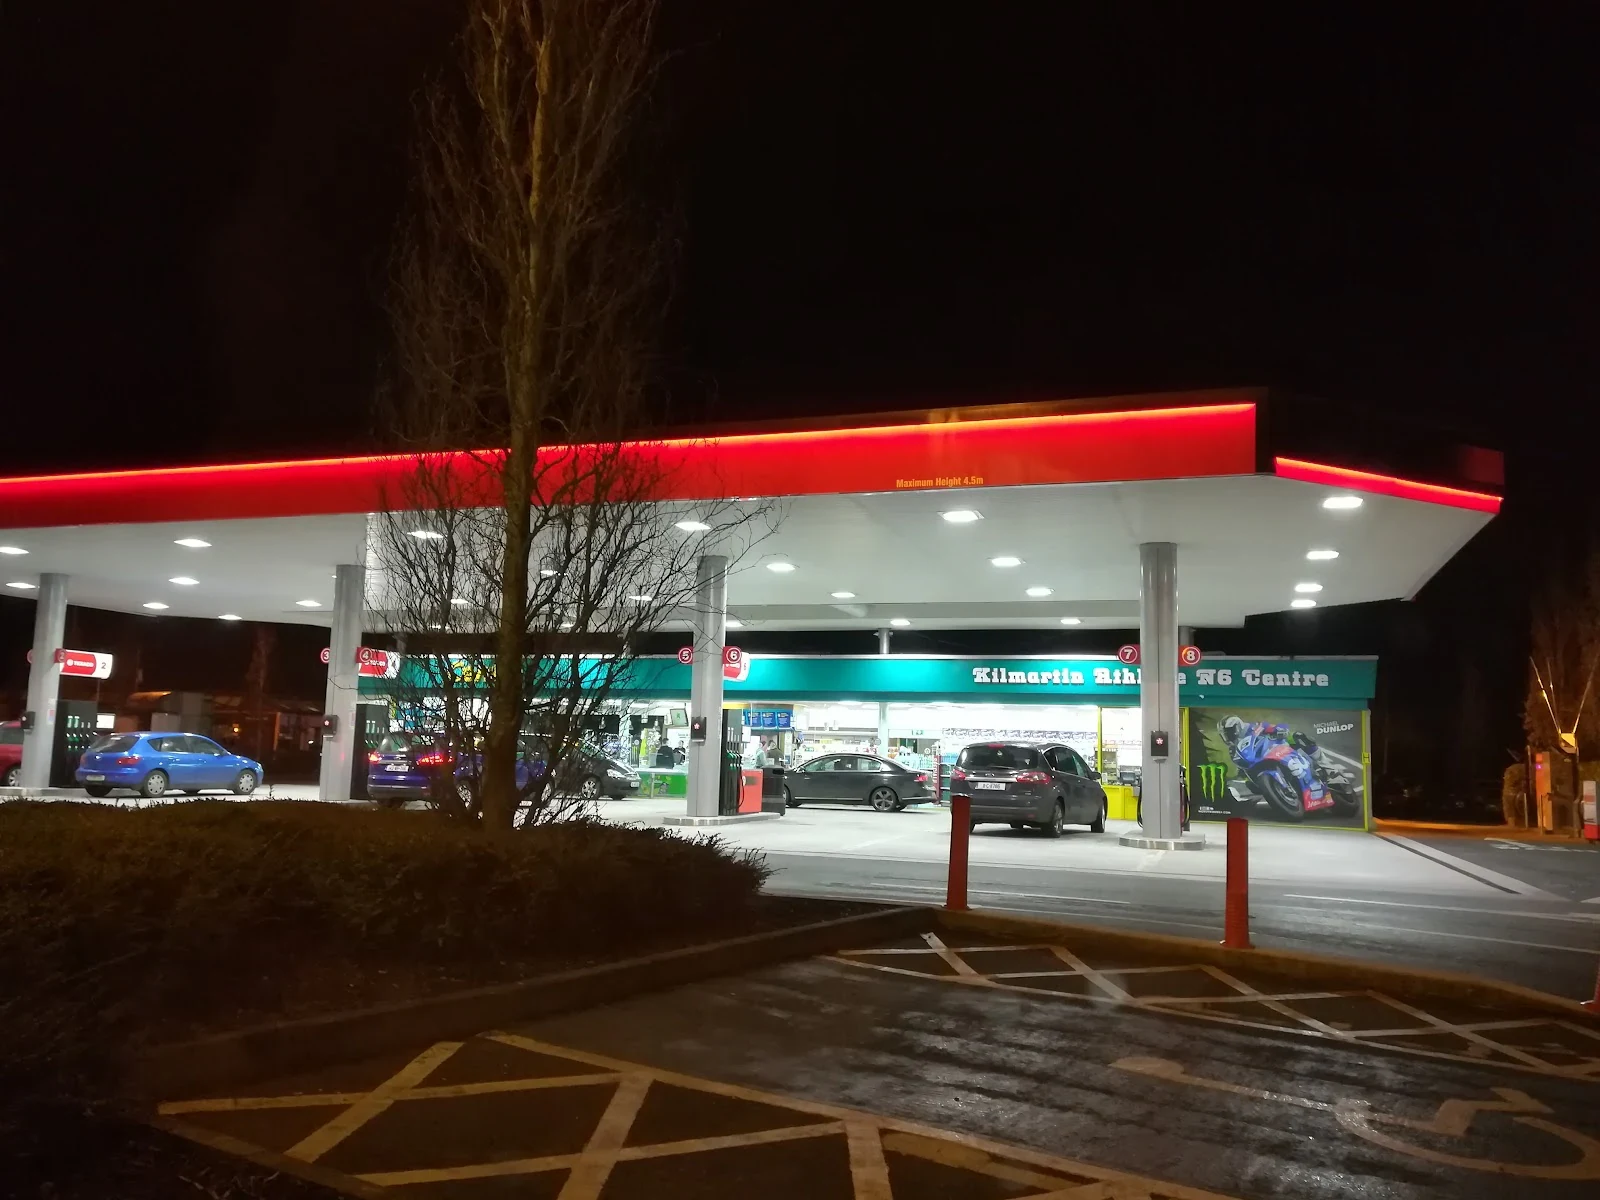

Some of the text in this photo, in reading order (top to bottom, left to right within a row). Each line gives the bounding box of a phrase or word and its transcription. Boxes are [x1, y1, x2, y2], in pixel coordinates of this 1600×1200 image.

[896, 476, 984, 488] Maximum Height 4.5m
[682, 650, 690, 660] 5
[729, 650, 738, 660] 6
[1123, 649, 1133, 660] 7
[1186, 650, 1195, 661] 8
[972, 667, 1329, 687] Kilmartin Athle N6 Centre
[1313, 720, 1339, 728] MICHAEL
[1316, 723, 1354, 735] DUNLOP
